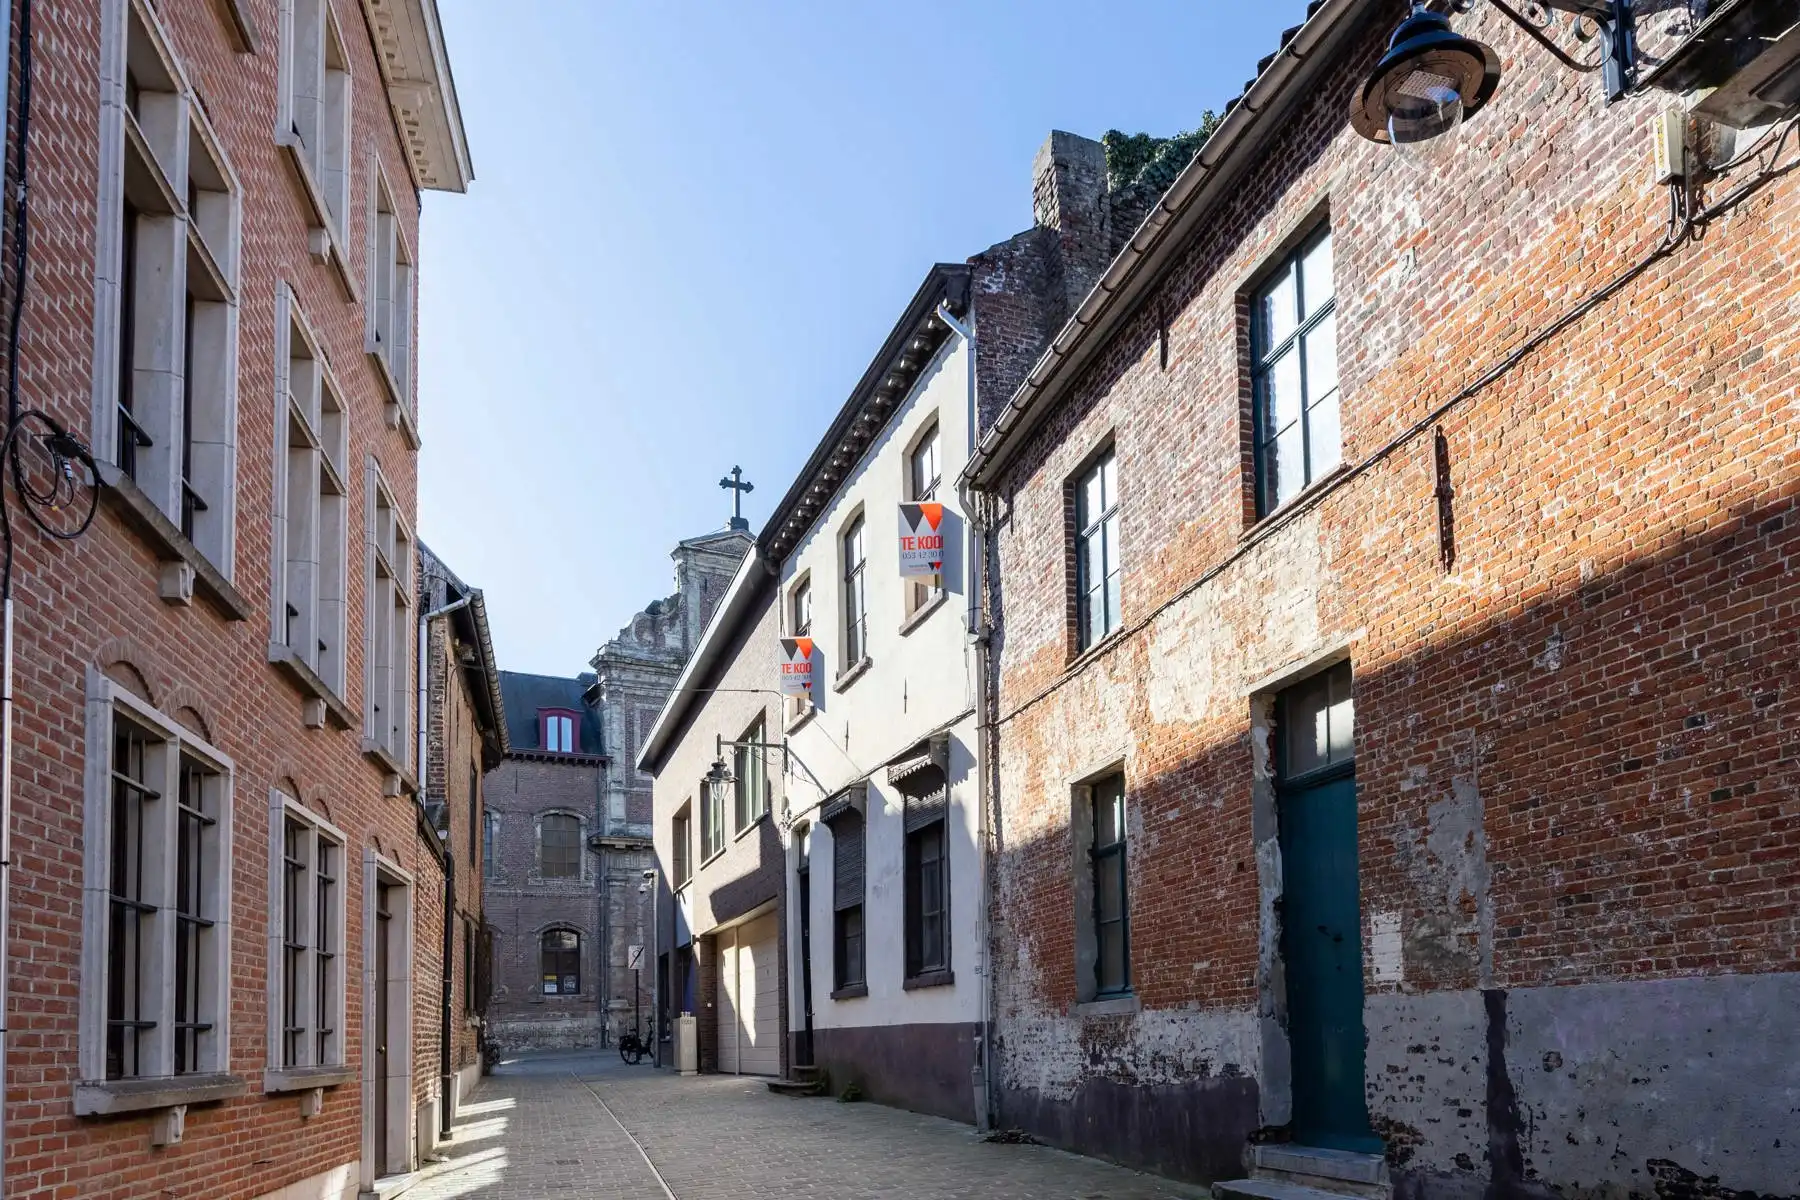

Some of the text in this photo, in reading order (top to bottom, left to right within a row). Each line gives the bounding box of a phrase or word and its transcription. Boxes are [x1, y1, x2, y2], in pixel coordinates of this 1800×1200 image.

[901, 536, 914, 550] TE
[781, 663, 812, 674] TE KOO
